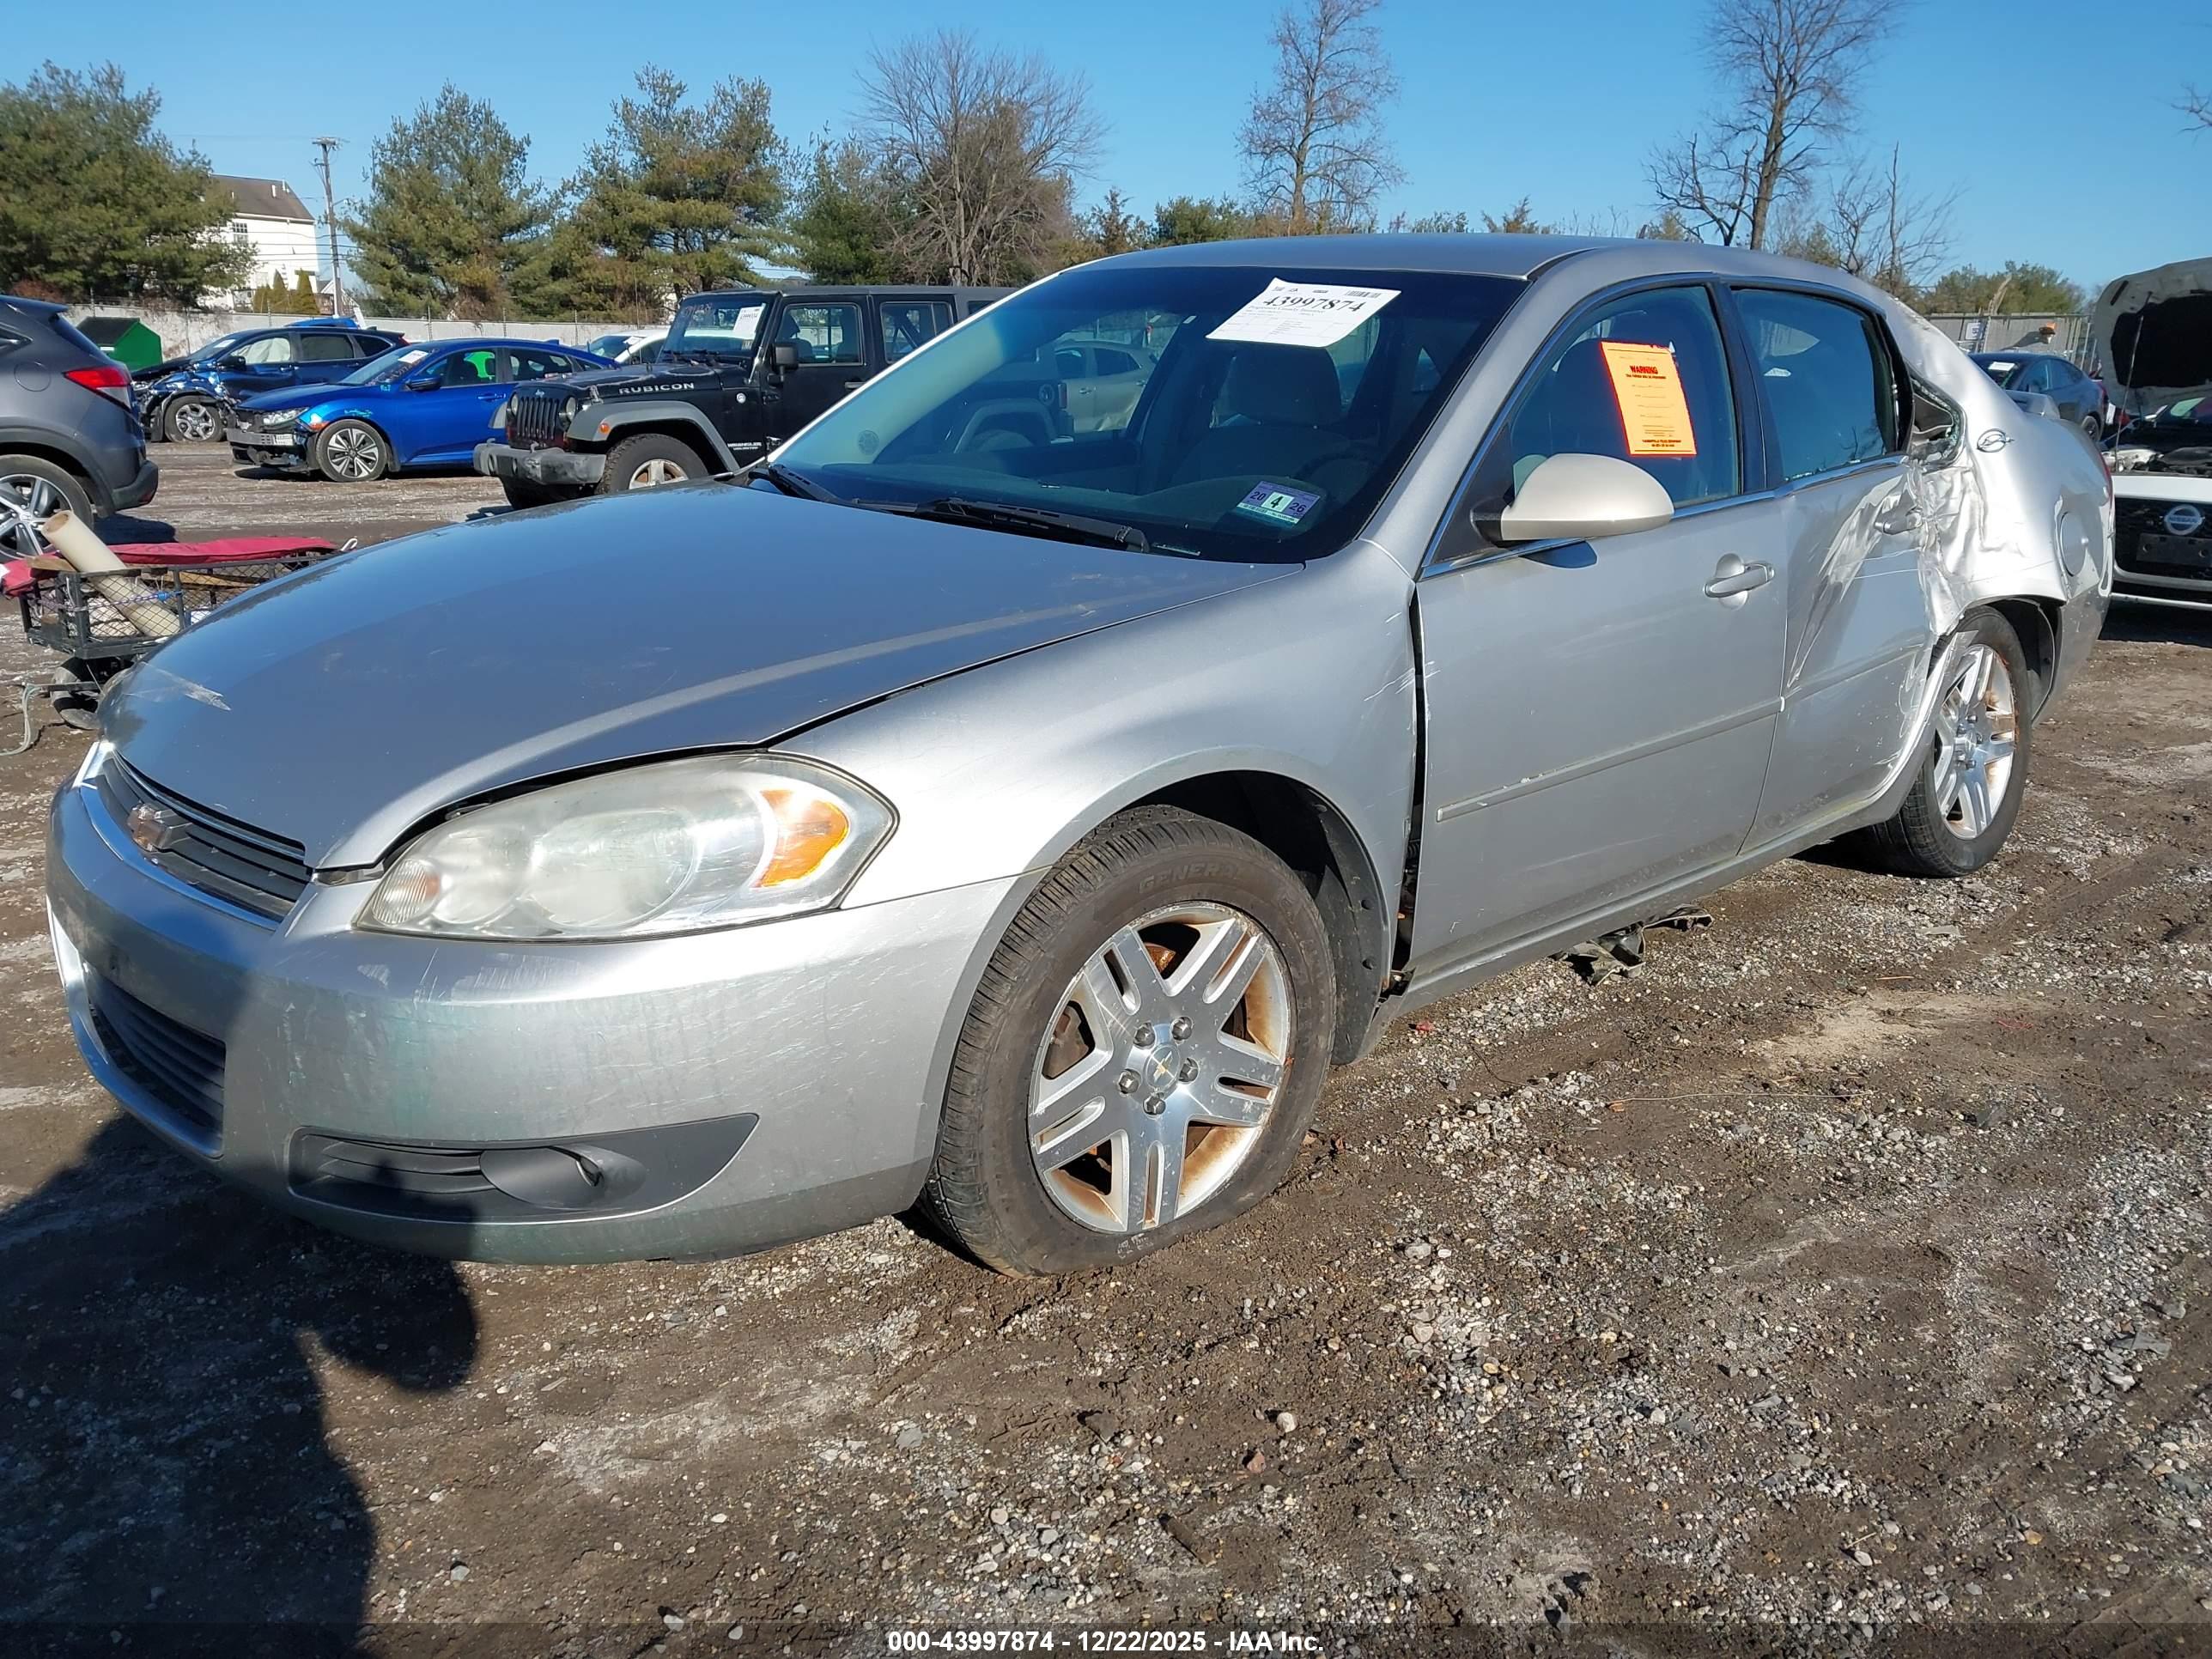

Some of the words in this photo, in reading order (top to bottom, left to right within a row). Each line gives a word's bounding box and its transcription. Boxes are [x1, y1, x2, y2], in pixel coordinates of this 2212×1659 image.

[1263, 295, 1366, 312] 43997874
[1629, 365, 1658, 374] WARNING
[618, 383, 695, 394] RUBICON
[1249, 491, 1267, 501] 20
[1270, 495, 1284, 508] 4
[1289, 502, 1306, 513] 26
